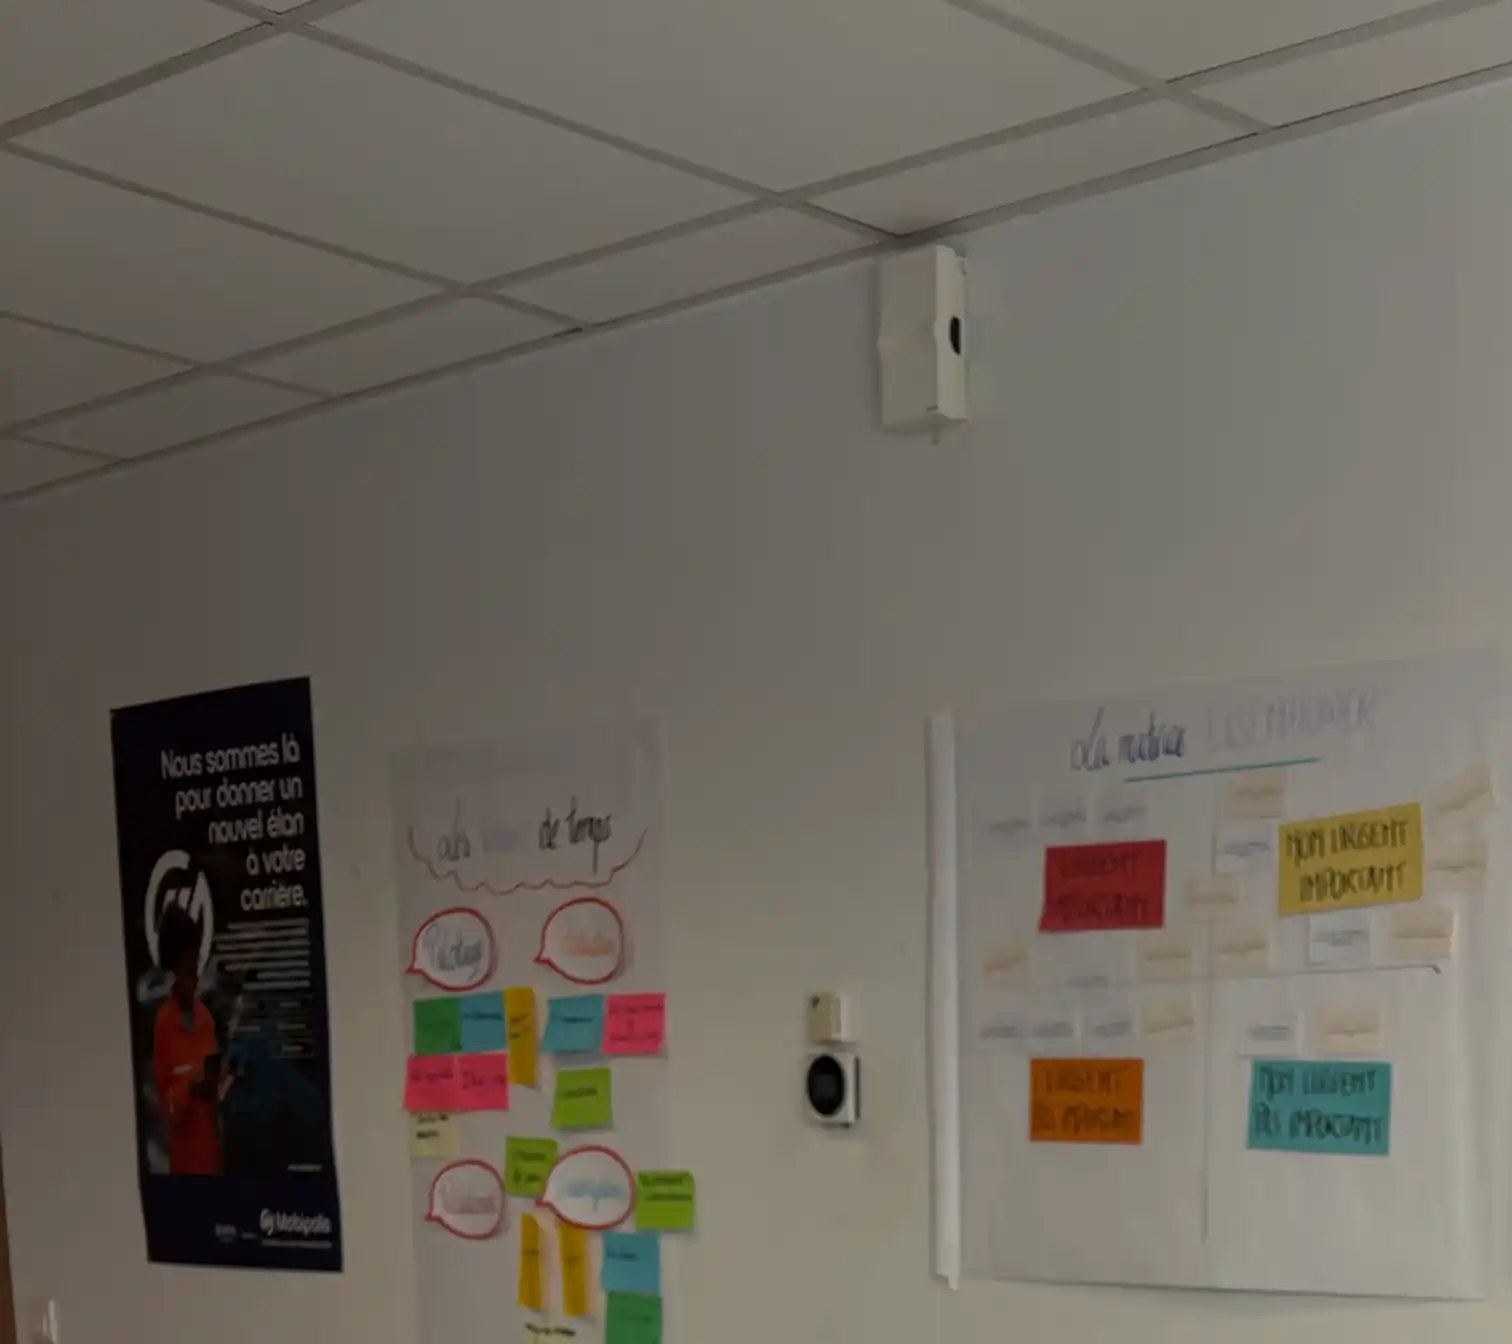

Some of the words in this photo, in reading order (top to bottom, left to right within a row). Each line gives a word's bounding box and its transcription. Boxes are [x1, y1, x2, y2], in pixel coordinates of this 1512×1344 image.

[160, 749, 203, 781] Nous
[205, 741, 281, 774] sommes
[175, 788, 212, 821] pour
[216, 777, 277, 809] donner
[278, 776, 304, 801] un
[208, 808, 264, 845] nouvel
[266, 805, 306, 839] élan
[261, 843, 307, 875] votre
